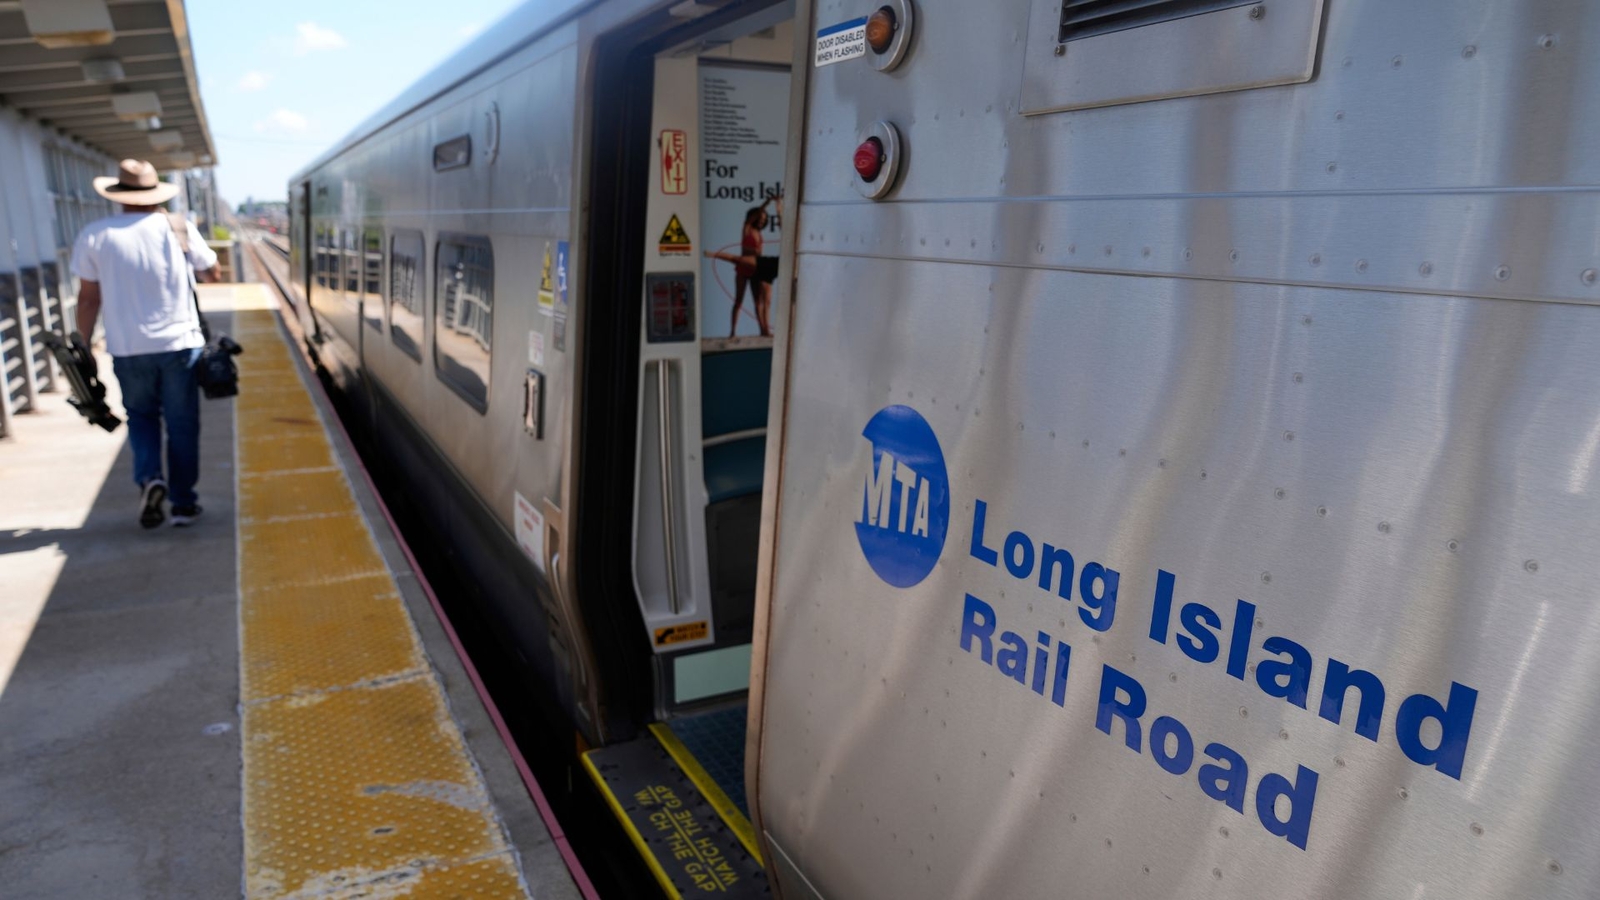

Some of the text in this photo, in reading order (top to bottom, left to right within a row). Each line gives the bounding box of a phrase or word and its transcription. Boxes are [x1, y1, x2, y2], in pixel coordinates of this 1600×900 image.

[817, 43, 864, 63] WHEN FLASHING
[818, 30, 865, 51] DOOR DISABLED
[673, 133, 684, 193] EXIT
[705, 159, 738, 178] For
[705, 181, 754, 203] Long
[855, 433, 930, 538] MTA
[970, 499, 1478, 781] Long Island
[960, 593, 1320, 851] Rail Road
[634, 788, 717, 892] WCH THE GAP
[655, 785, 740, 886] WATCH THE GAP
